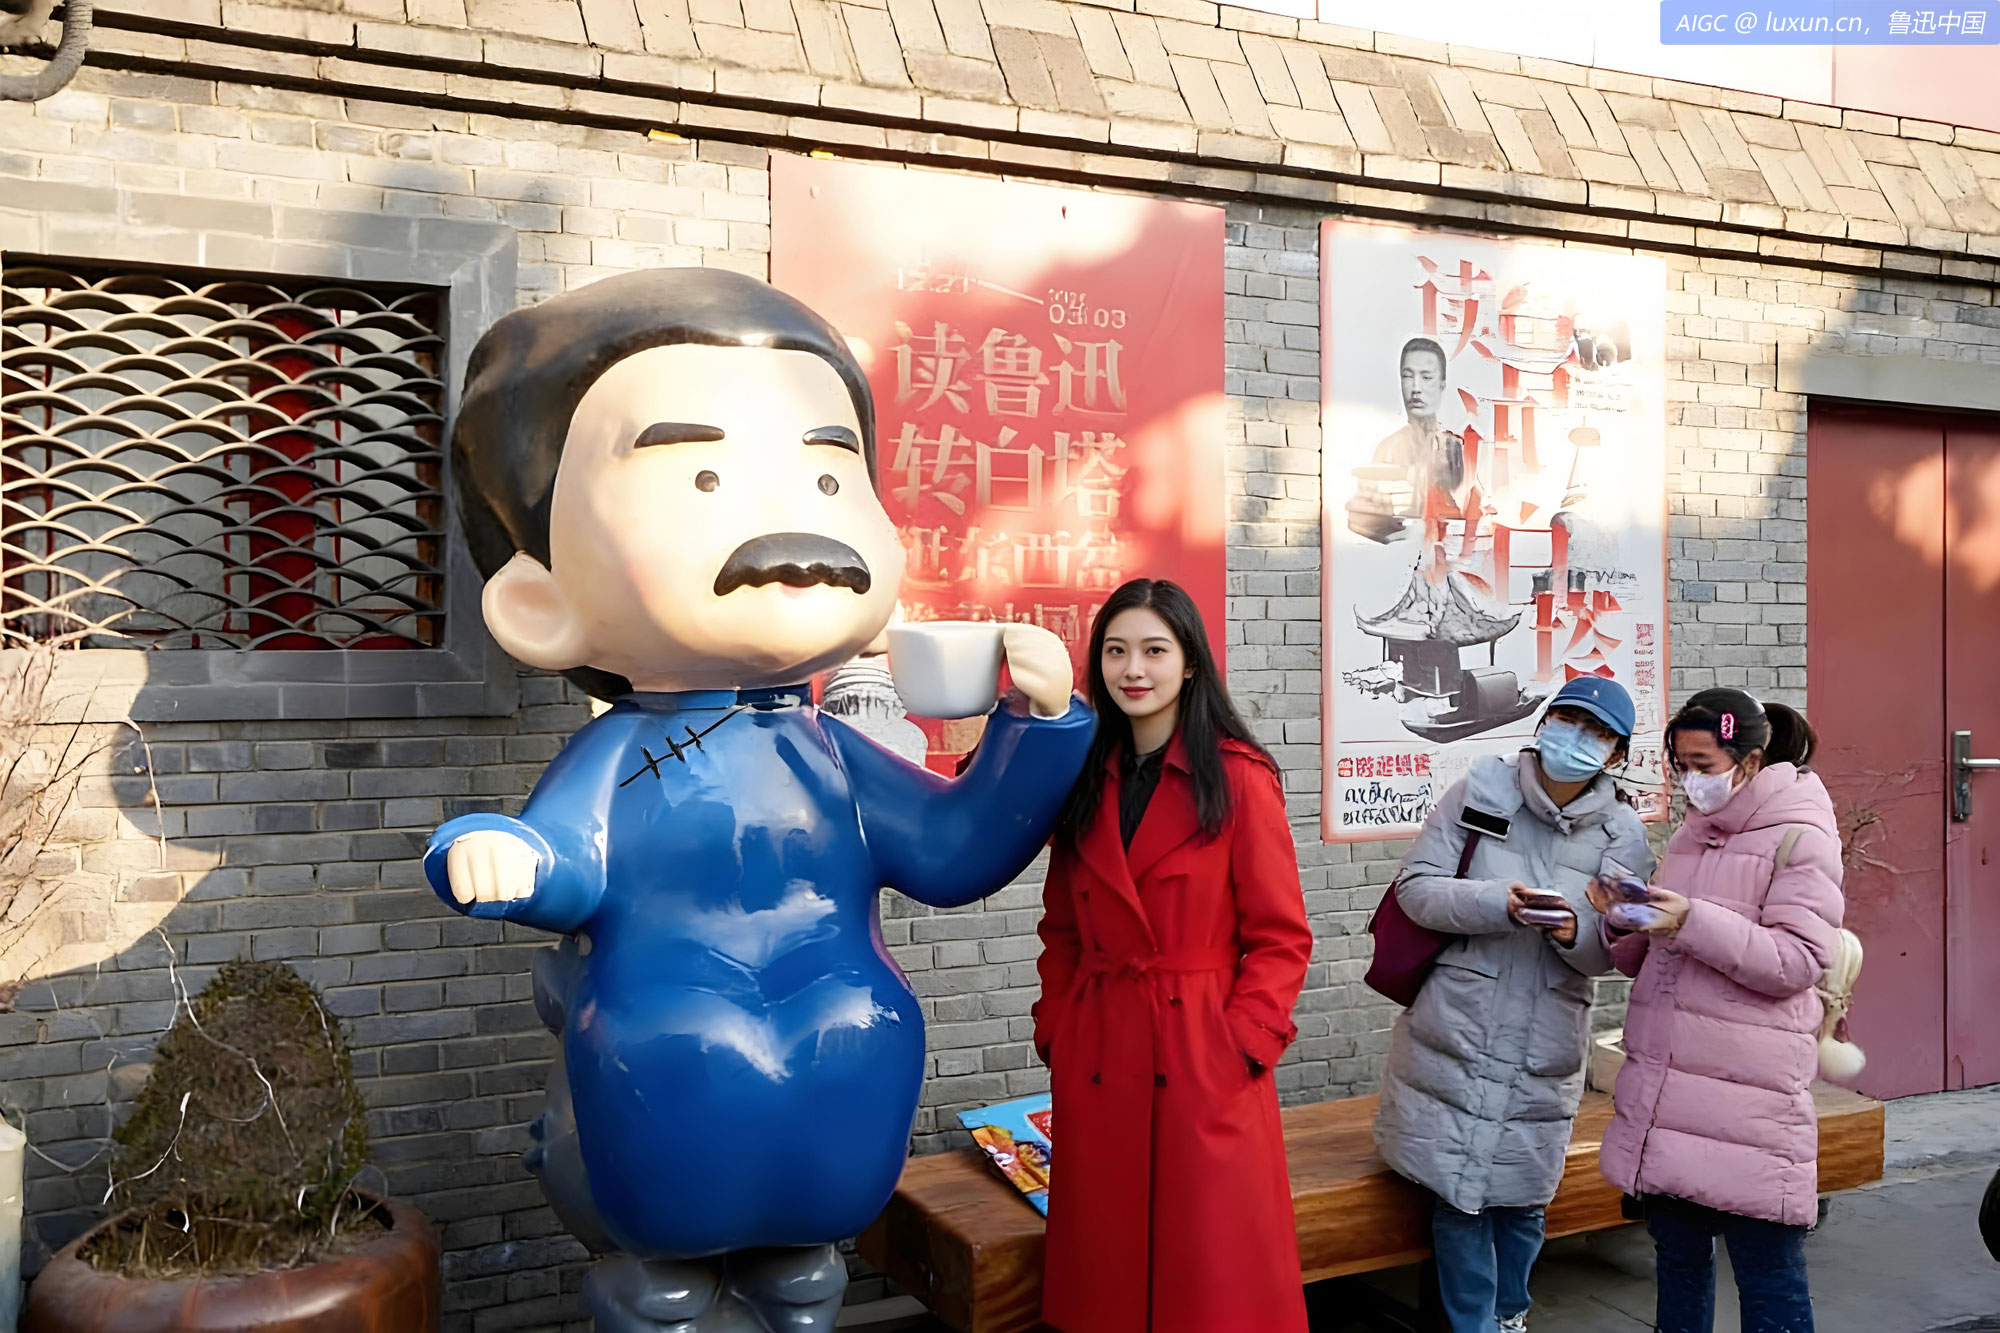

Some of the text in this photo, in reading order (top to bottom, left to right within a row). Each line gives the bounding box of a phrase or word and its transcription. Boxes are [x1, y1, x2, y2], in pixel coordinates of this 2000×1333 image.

[887, 320, 1128, 418] 读鲁迅
[887, 421, 1128, 517] 转白塔
